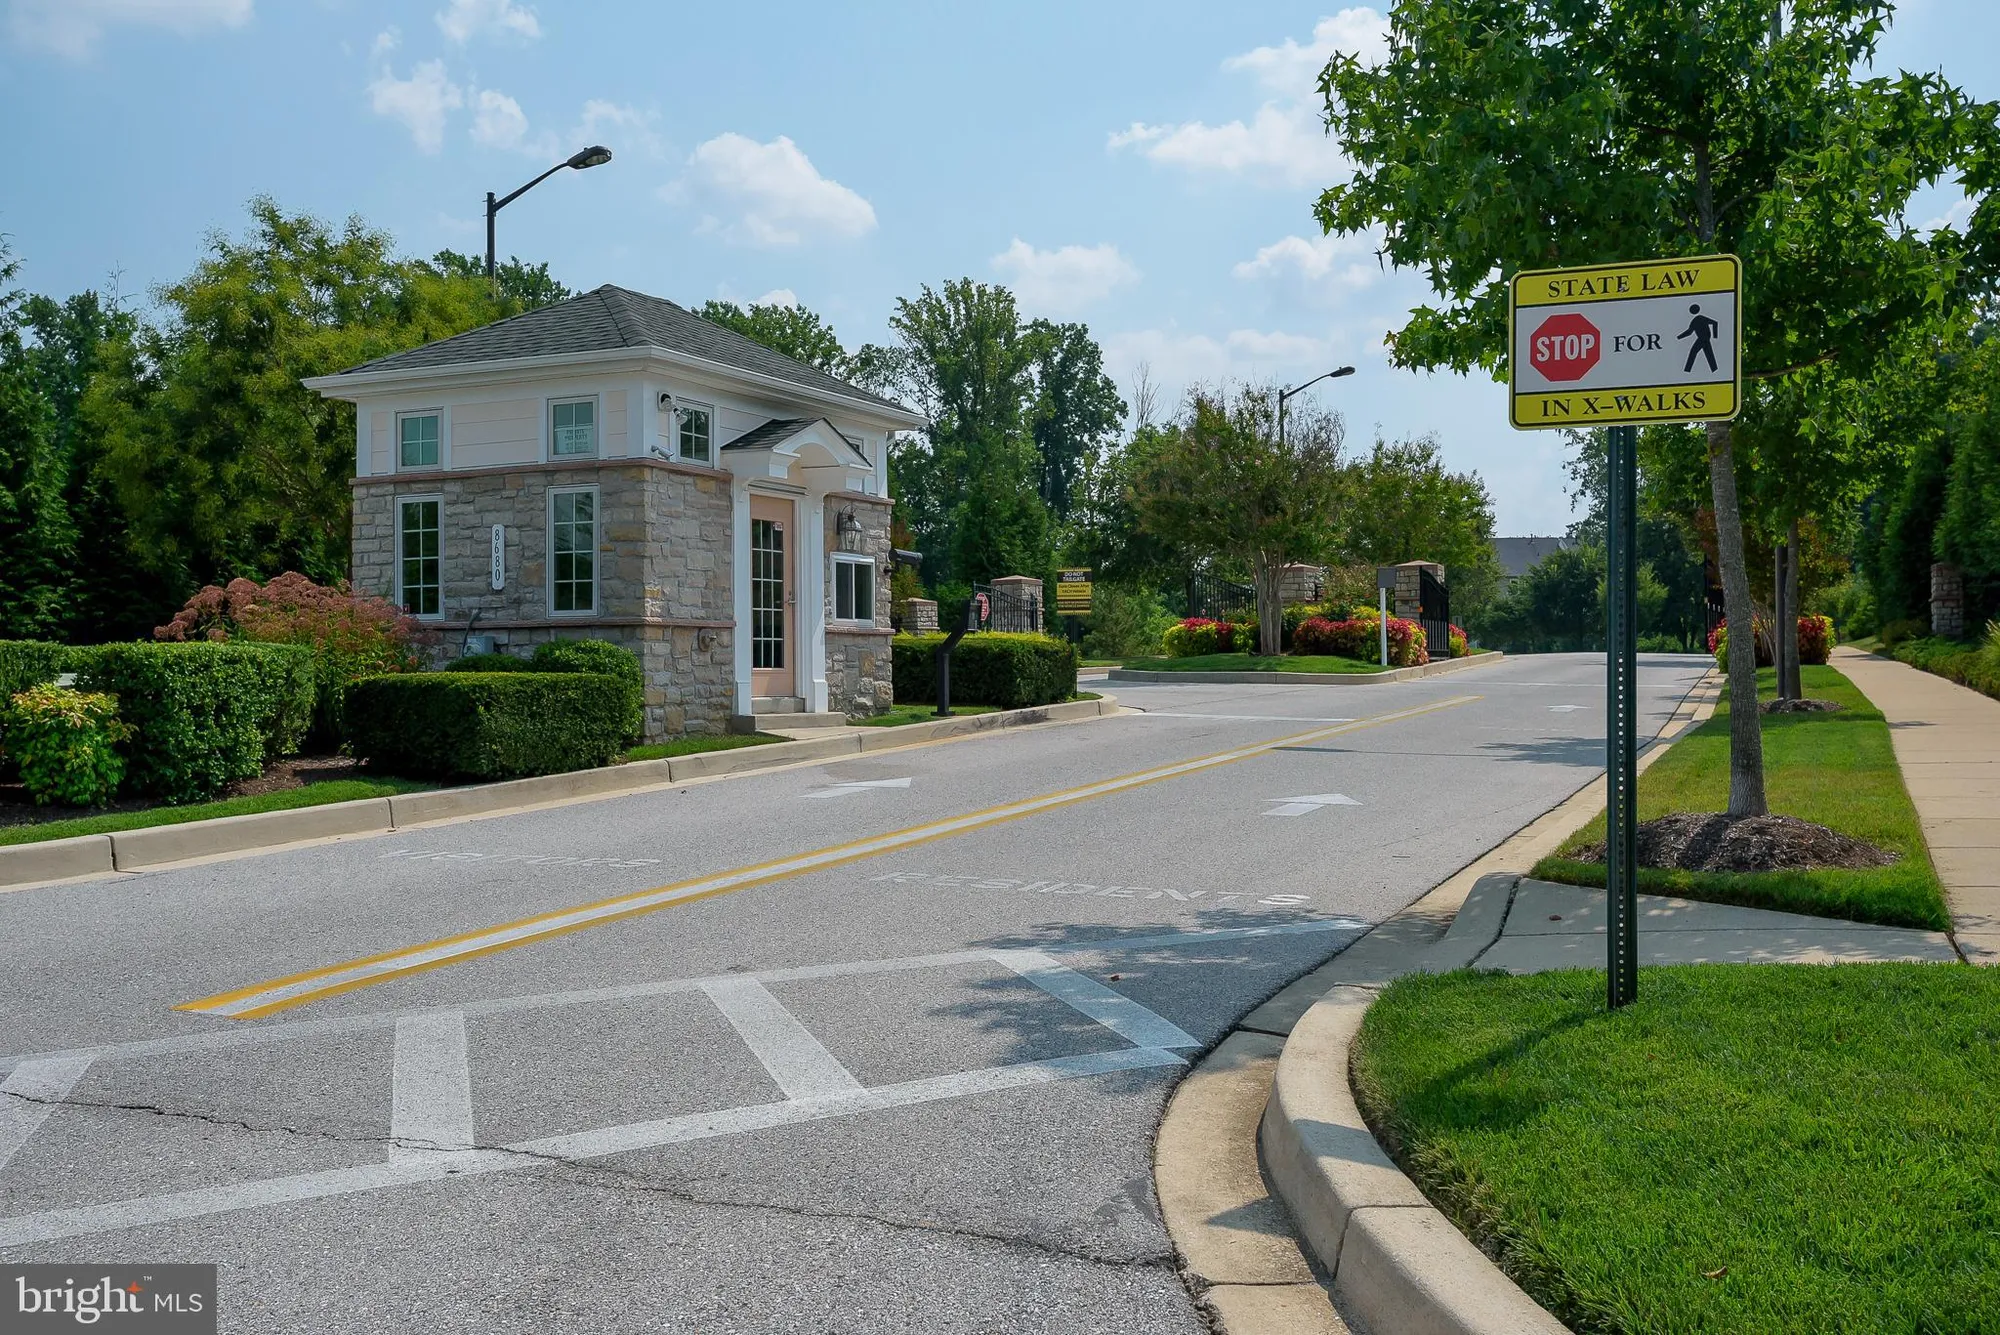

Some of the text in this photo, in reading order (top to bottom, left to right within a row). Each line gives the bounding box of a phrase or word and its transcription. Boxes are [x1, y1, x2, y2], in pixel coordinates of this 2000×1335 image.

[1548, 269, 1700, 298] STATE LAW
[1536, 333, 1662, 362] STOP FOR
[1541, 391, 1706, 417] IN X-WALKS
[870, 872, 1311, 906] RESIDENTS
